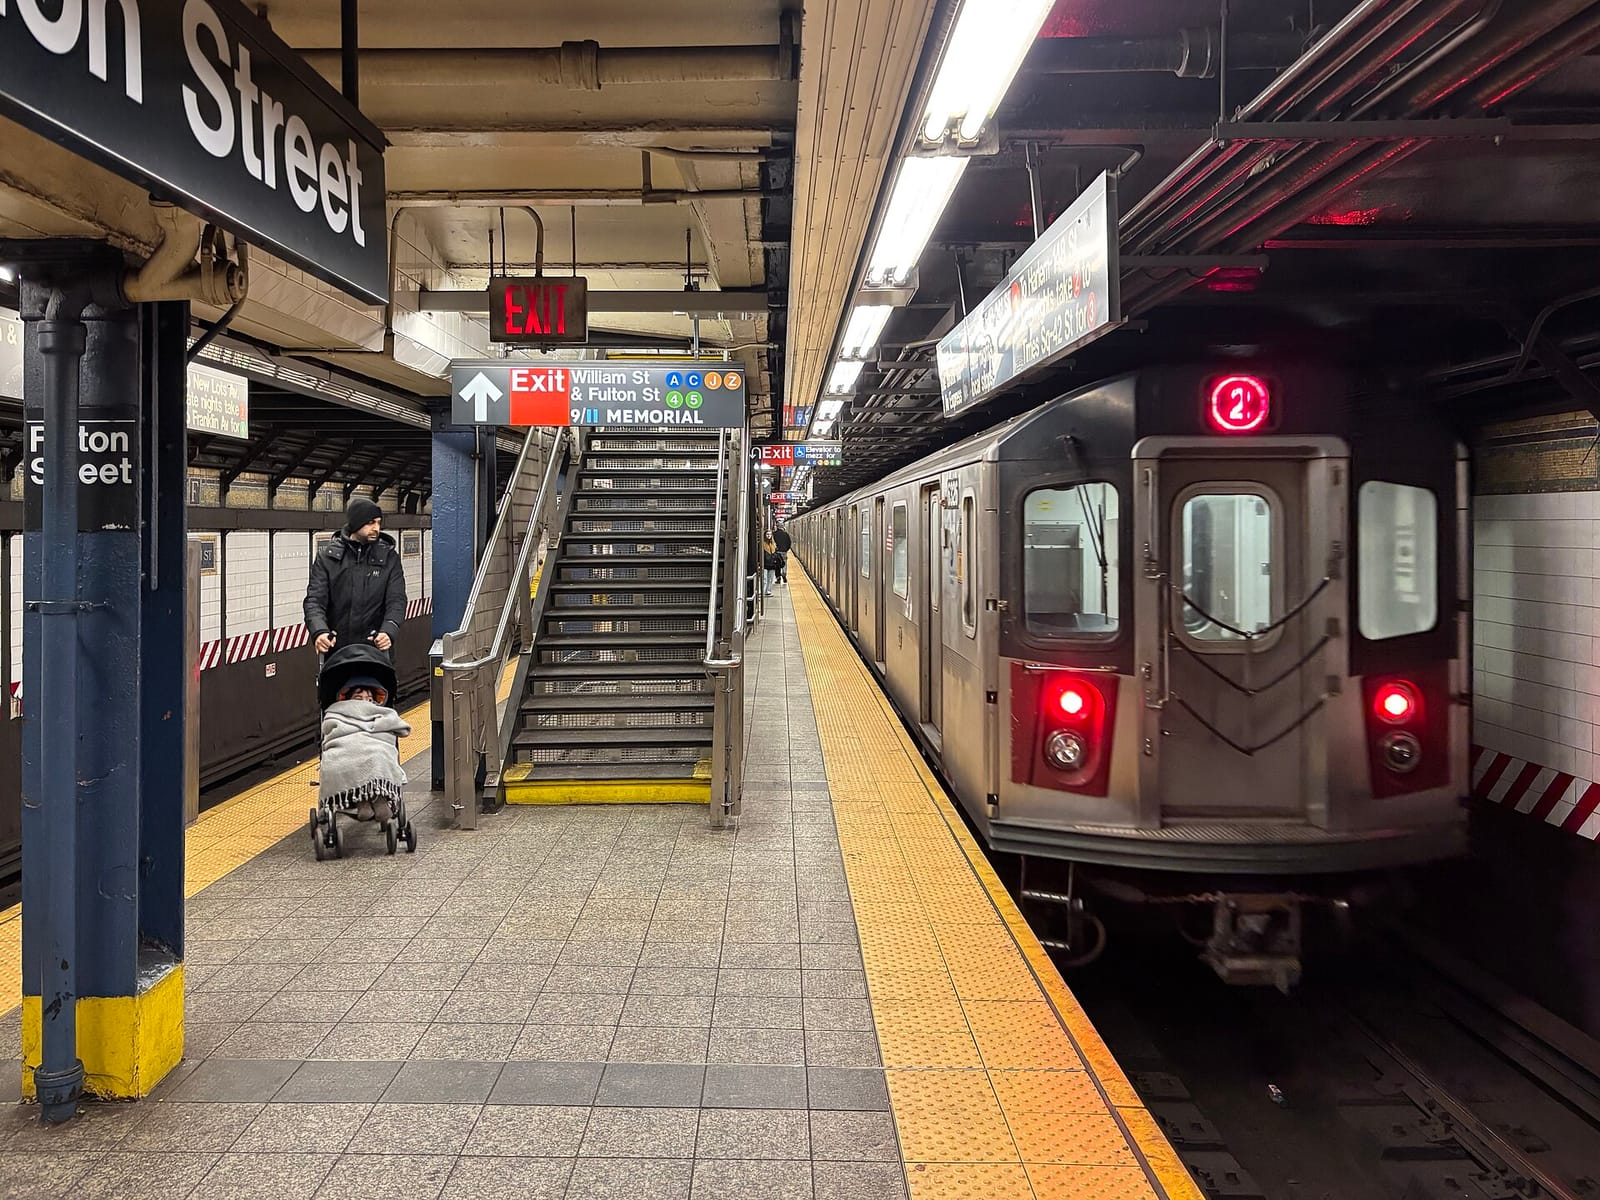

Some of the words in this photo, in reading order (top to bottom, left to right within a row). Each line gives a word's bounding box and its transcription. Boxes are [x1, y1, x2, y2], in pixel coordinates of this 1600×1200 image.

[182, 0, 365, 248] Street
[1056, 275, 1073, 307] take
[1082, 262, 1092, 288] to
[505, 284, 568, 334] EXIT
[1064, 309, 1073, 341] St
[1075, 300, 1087, 331] for
[1088, 301, 1095, 323] 3
[194, 373, 210, 393] New
[211, 379, 228, 397] Lots
[511, 369, 565, 392] Exit
[571, 369, 626, 384] William
[632, 370, 650, 385] St
[669, 374, 680, 385] A
[688, 374, 699, 386] C
[709, 374, 717, 386] J
[728, 374, 737, 386] Z
[200, 394, 222, 413] nights
[224, 400, 240, 417] take
[570, 390, 582, 402] &
[588, 387, 636, 402] Fulton
[642, 388, 661, 402] St
[669, 394, 679, 405] 4
[690, 394, 698, 405] 5
[1229, 387, 1251, 420] 2
[192, 410, 220, 430] Franklin
[606, 410, 704, 424] MEMORIAL
[30, 425, 129, 453] Fton
[762, 446, 791, 459] Exit
[30, 457, 133, 485] Seet
